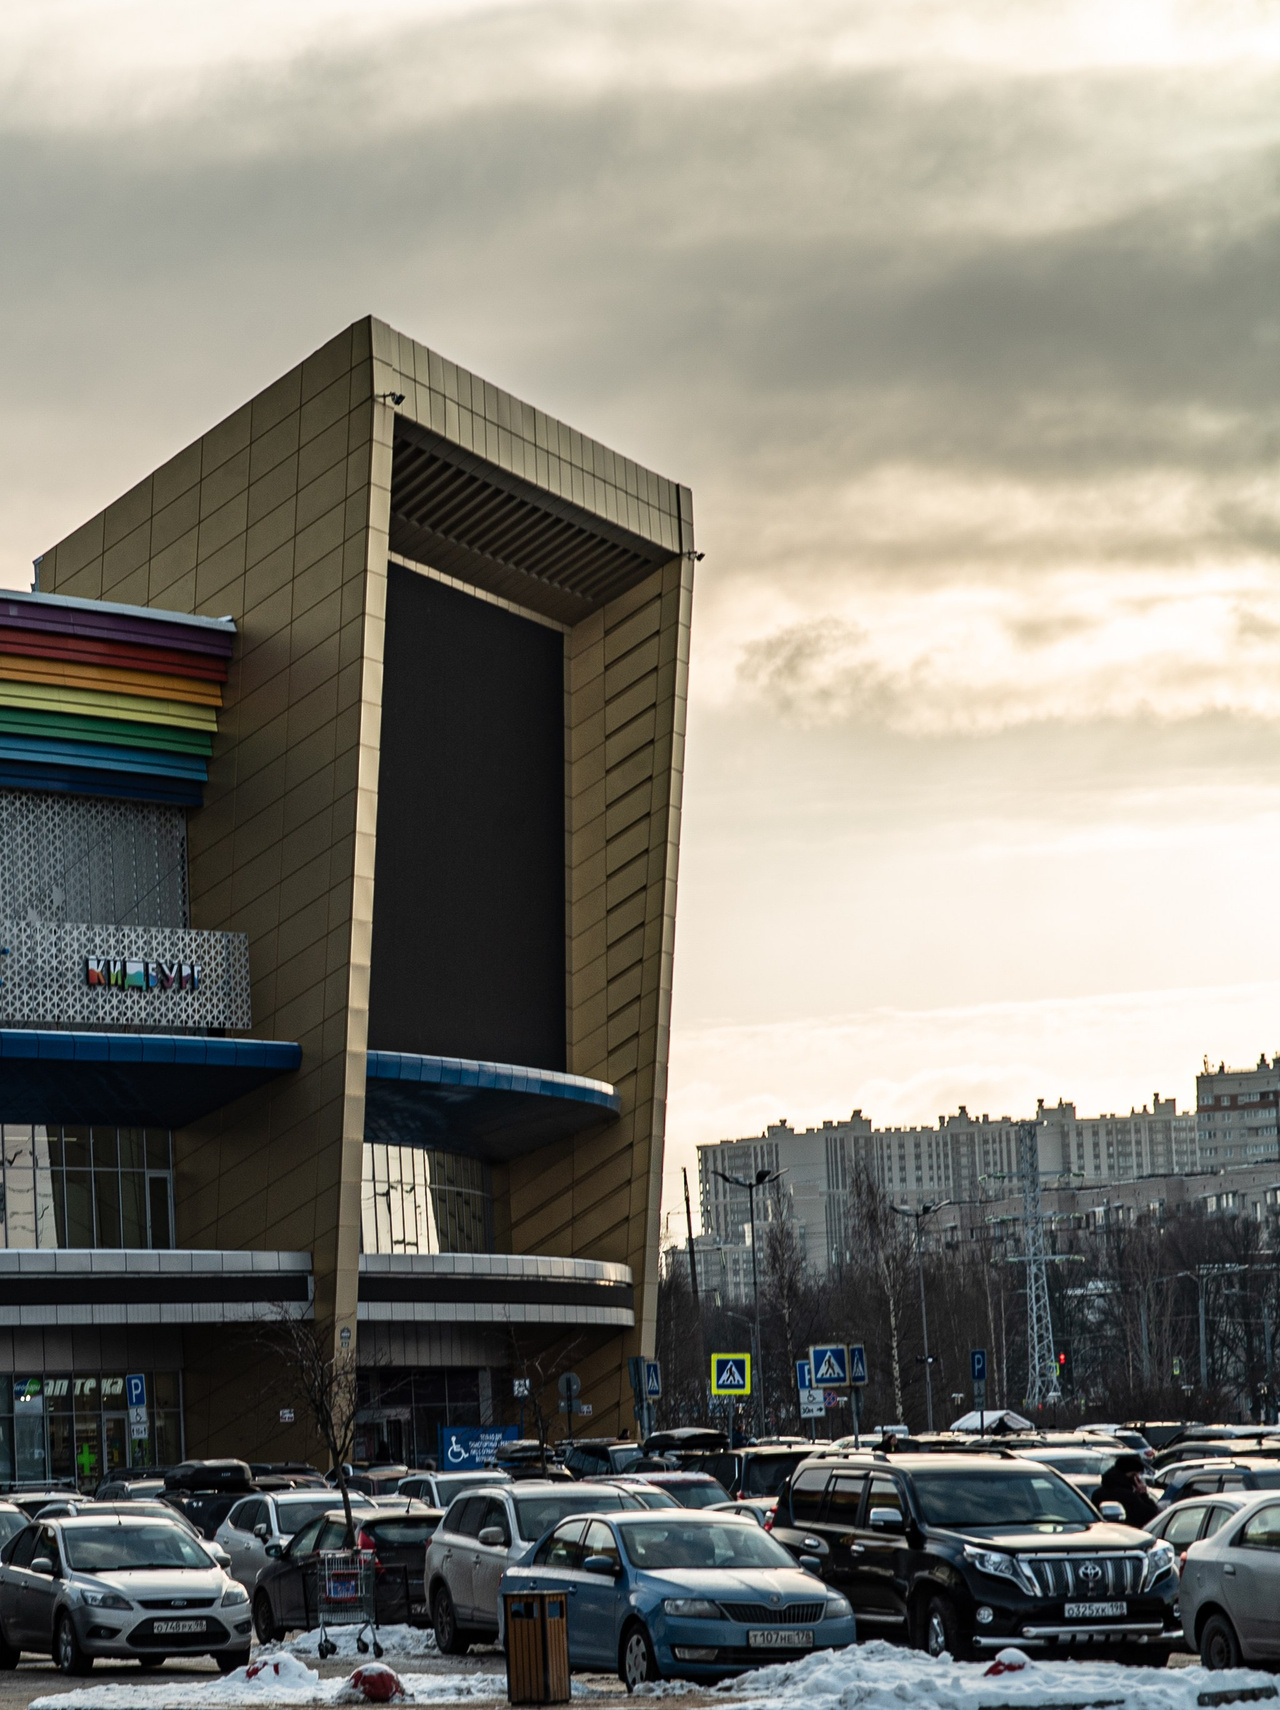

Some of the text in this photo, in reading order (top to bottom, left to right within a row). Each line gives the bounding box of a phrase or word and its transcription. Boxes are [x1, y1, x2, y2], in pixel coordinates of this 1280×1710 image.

[87, 956, 202, 991] КИДБУРГ
[974, 1353, 983, 1377] P
[44, 1377, 124, 1397] аптека
[131, 1378, 142, 1404] P
